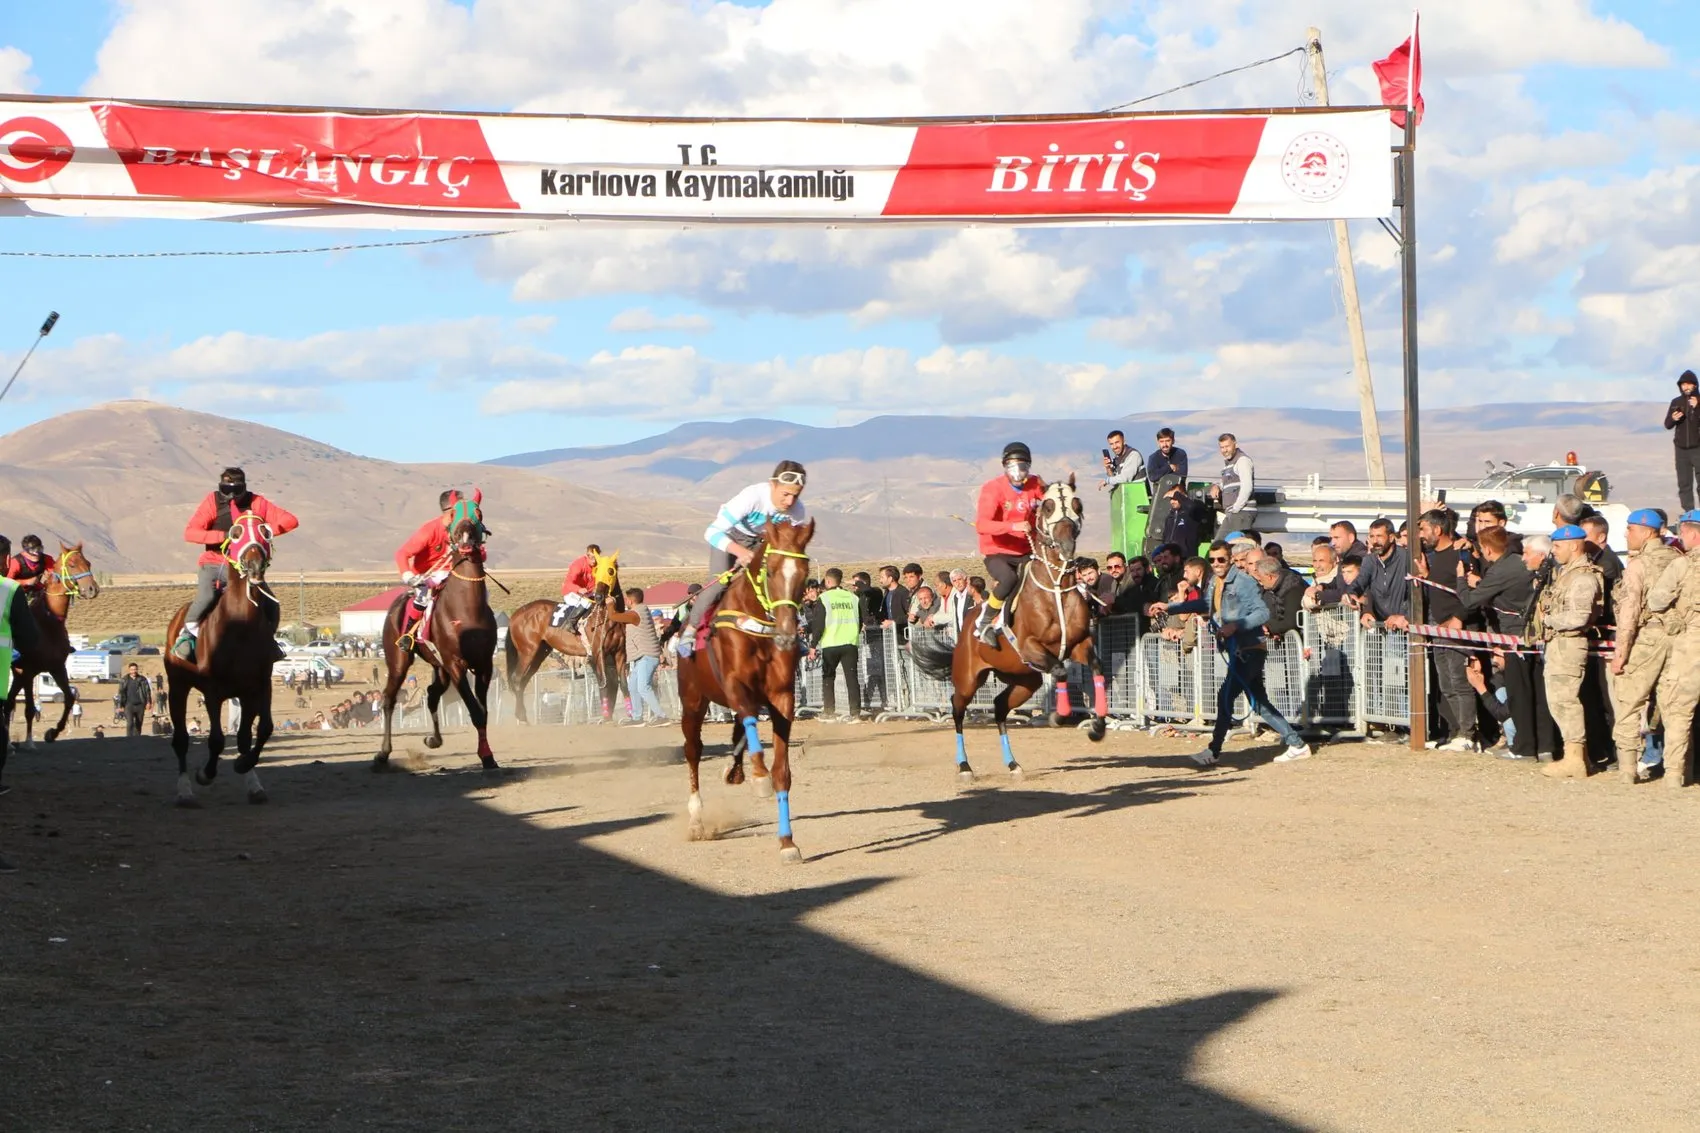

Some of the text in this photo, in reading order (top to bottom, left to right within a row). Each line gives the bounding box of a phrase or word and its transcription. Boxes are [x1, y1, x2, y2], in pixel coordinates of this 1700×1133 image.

[541, 169, 854, 201] Karlıova Kaymakamlığı
[985, 140, 1160, 201] BİTİŞ
